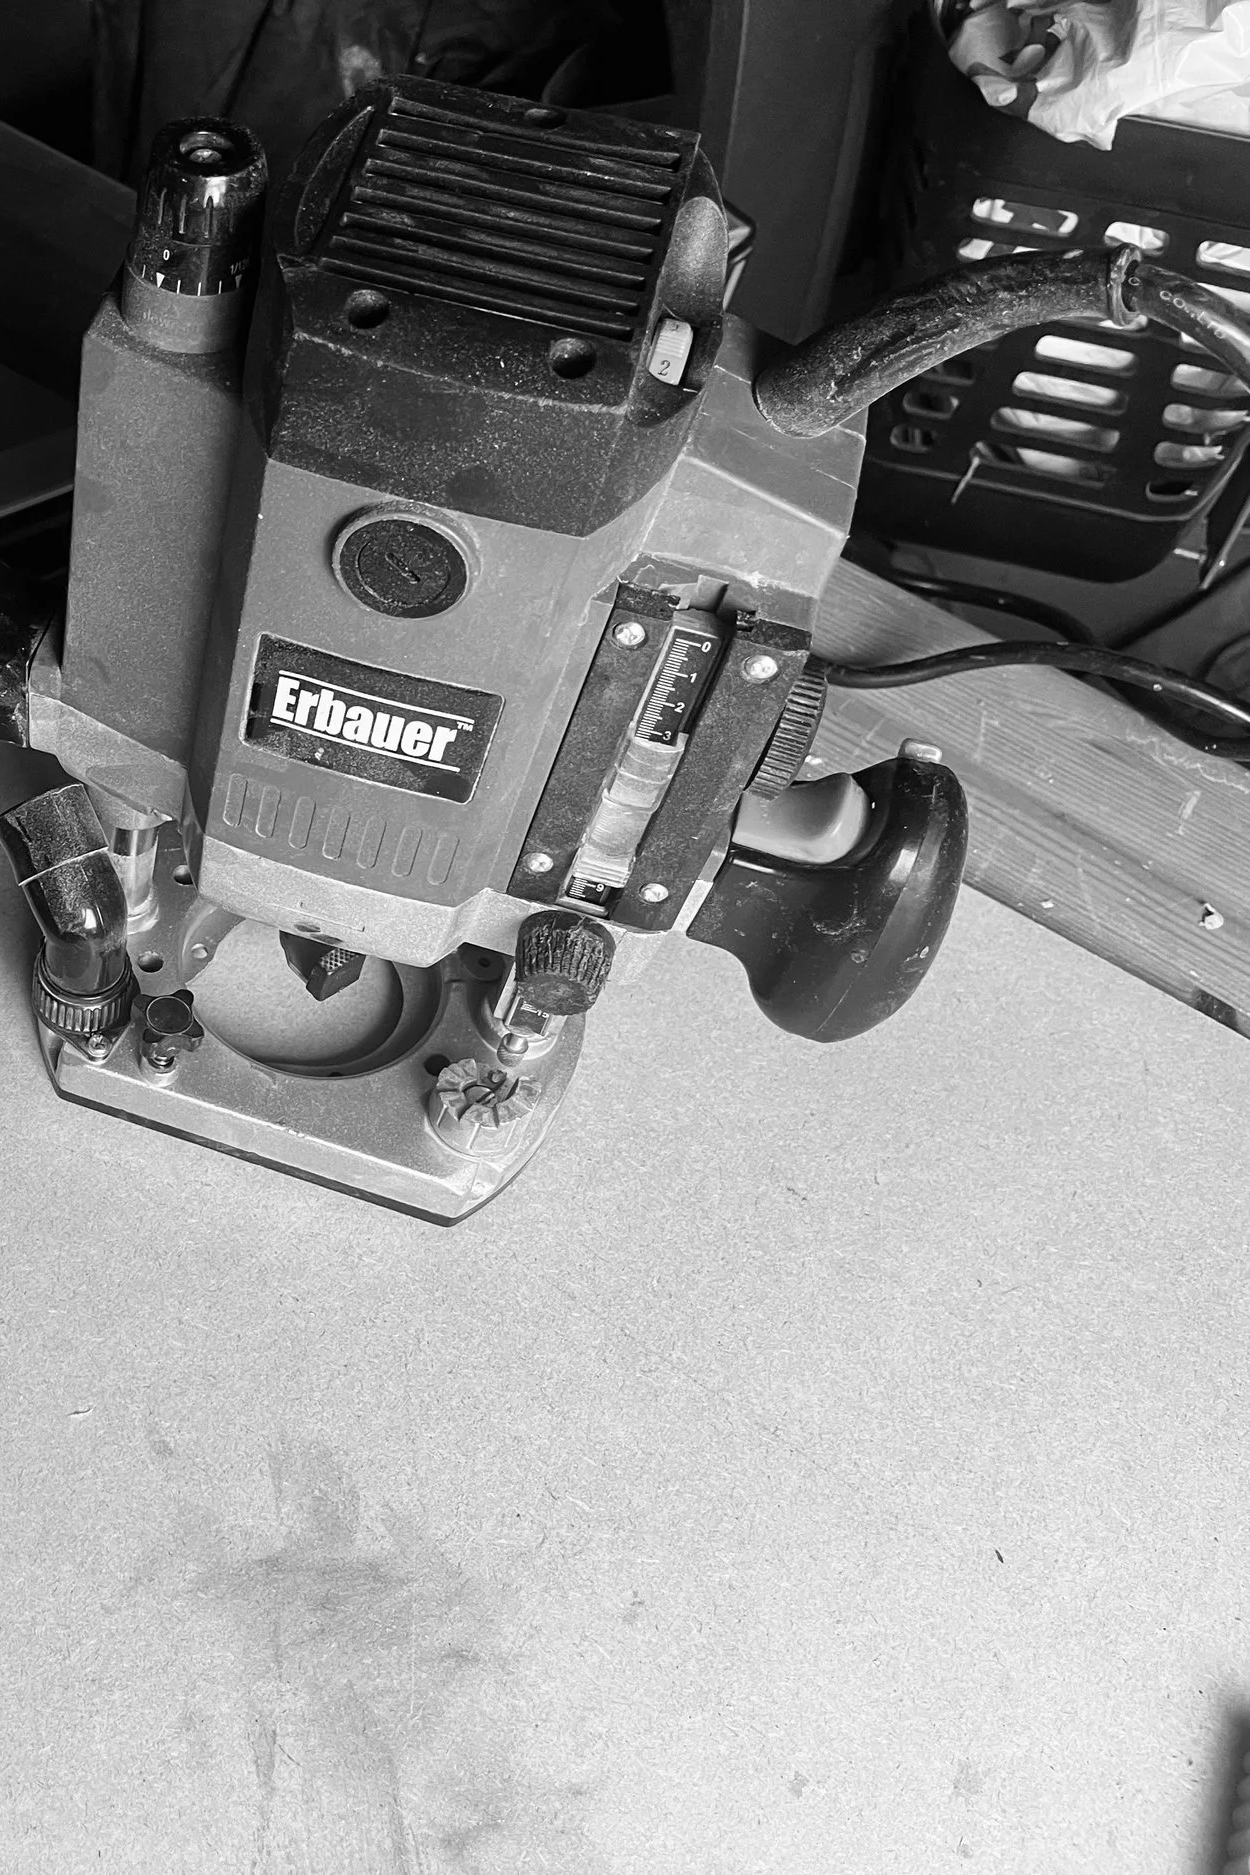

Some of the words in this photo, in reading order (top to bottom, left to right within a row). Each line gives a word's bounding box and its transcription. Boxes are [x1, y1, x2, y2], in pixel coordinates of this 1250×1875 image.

[163, 249, 170, 261] 0
[657, 359, 671, 376] 2
[701, 641, 712, 653] 0
[689, 672, 698, 683] 1
[674, 702, 685, 714] 2
[662, 730, 672, 741] 3
[595, 883, 605, 893] 9
